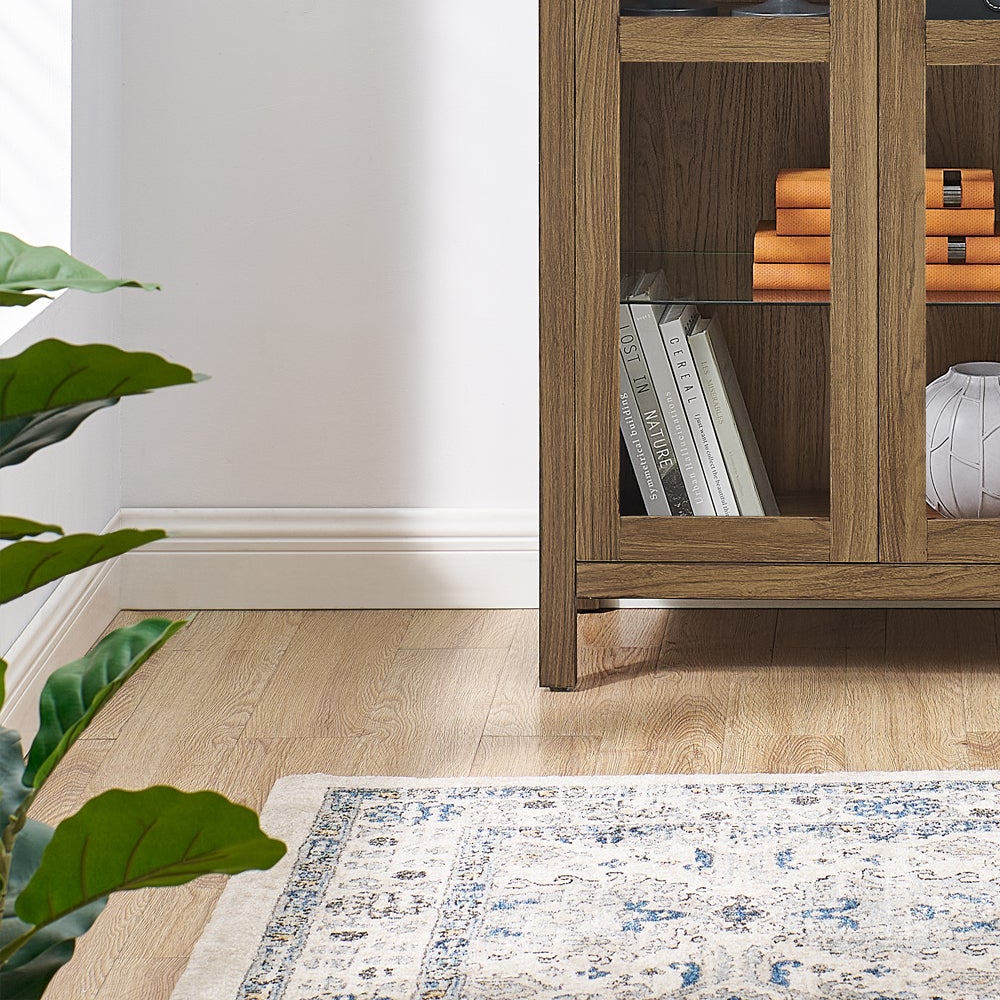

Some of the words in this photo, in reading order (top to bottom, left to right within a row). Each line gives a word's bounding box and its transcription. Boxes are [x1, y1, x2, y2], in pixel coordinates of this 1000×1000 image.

[669, 337, 697, 404] CEREAL
[700, 361, 709, 375] LES
[620, 392, 638, 437] building
[633, 375, 650, 394] IN
[643, 409, 675, 469] NATURE
[664, 391, 694, 471] Hallucinations
[632, 439, 658, 501] Symmetrical
[689, 472, 704, 505] Urban
[694, 417, 703, 428] just
[700, 428, 708, 443] want
[706, 450, 716, 469] collect
[715, 479, 727, 505] beautiful
